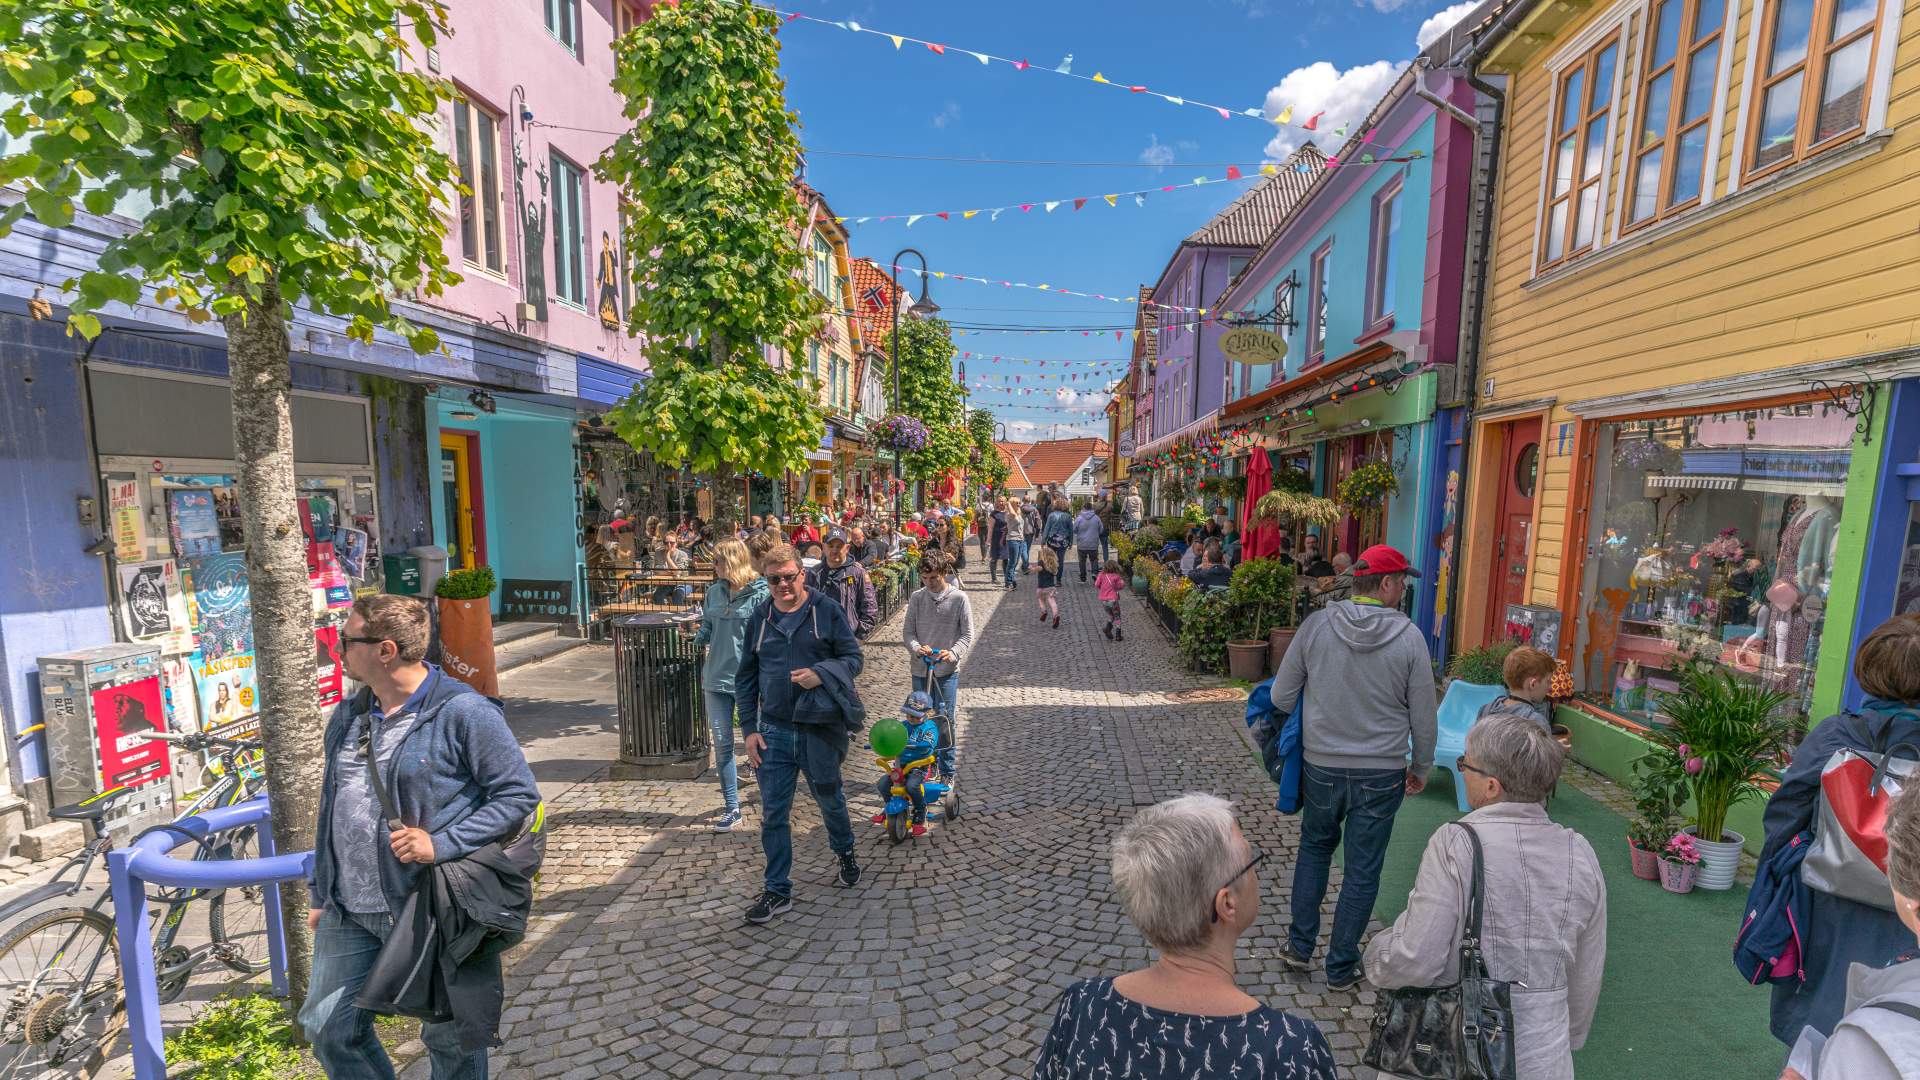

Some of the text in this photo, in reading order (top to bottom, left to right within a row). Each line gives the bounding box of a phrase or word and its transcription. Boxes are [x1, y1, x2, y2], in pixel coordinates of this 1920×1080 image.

[573, 444, 584, 548] TATTOO
[513, 590, 560, 600] SOLID
[504, 603, 568, 615] TATTOO
